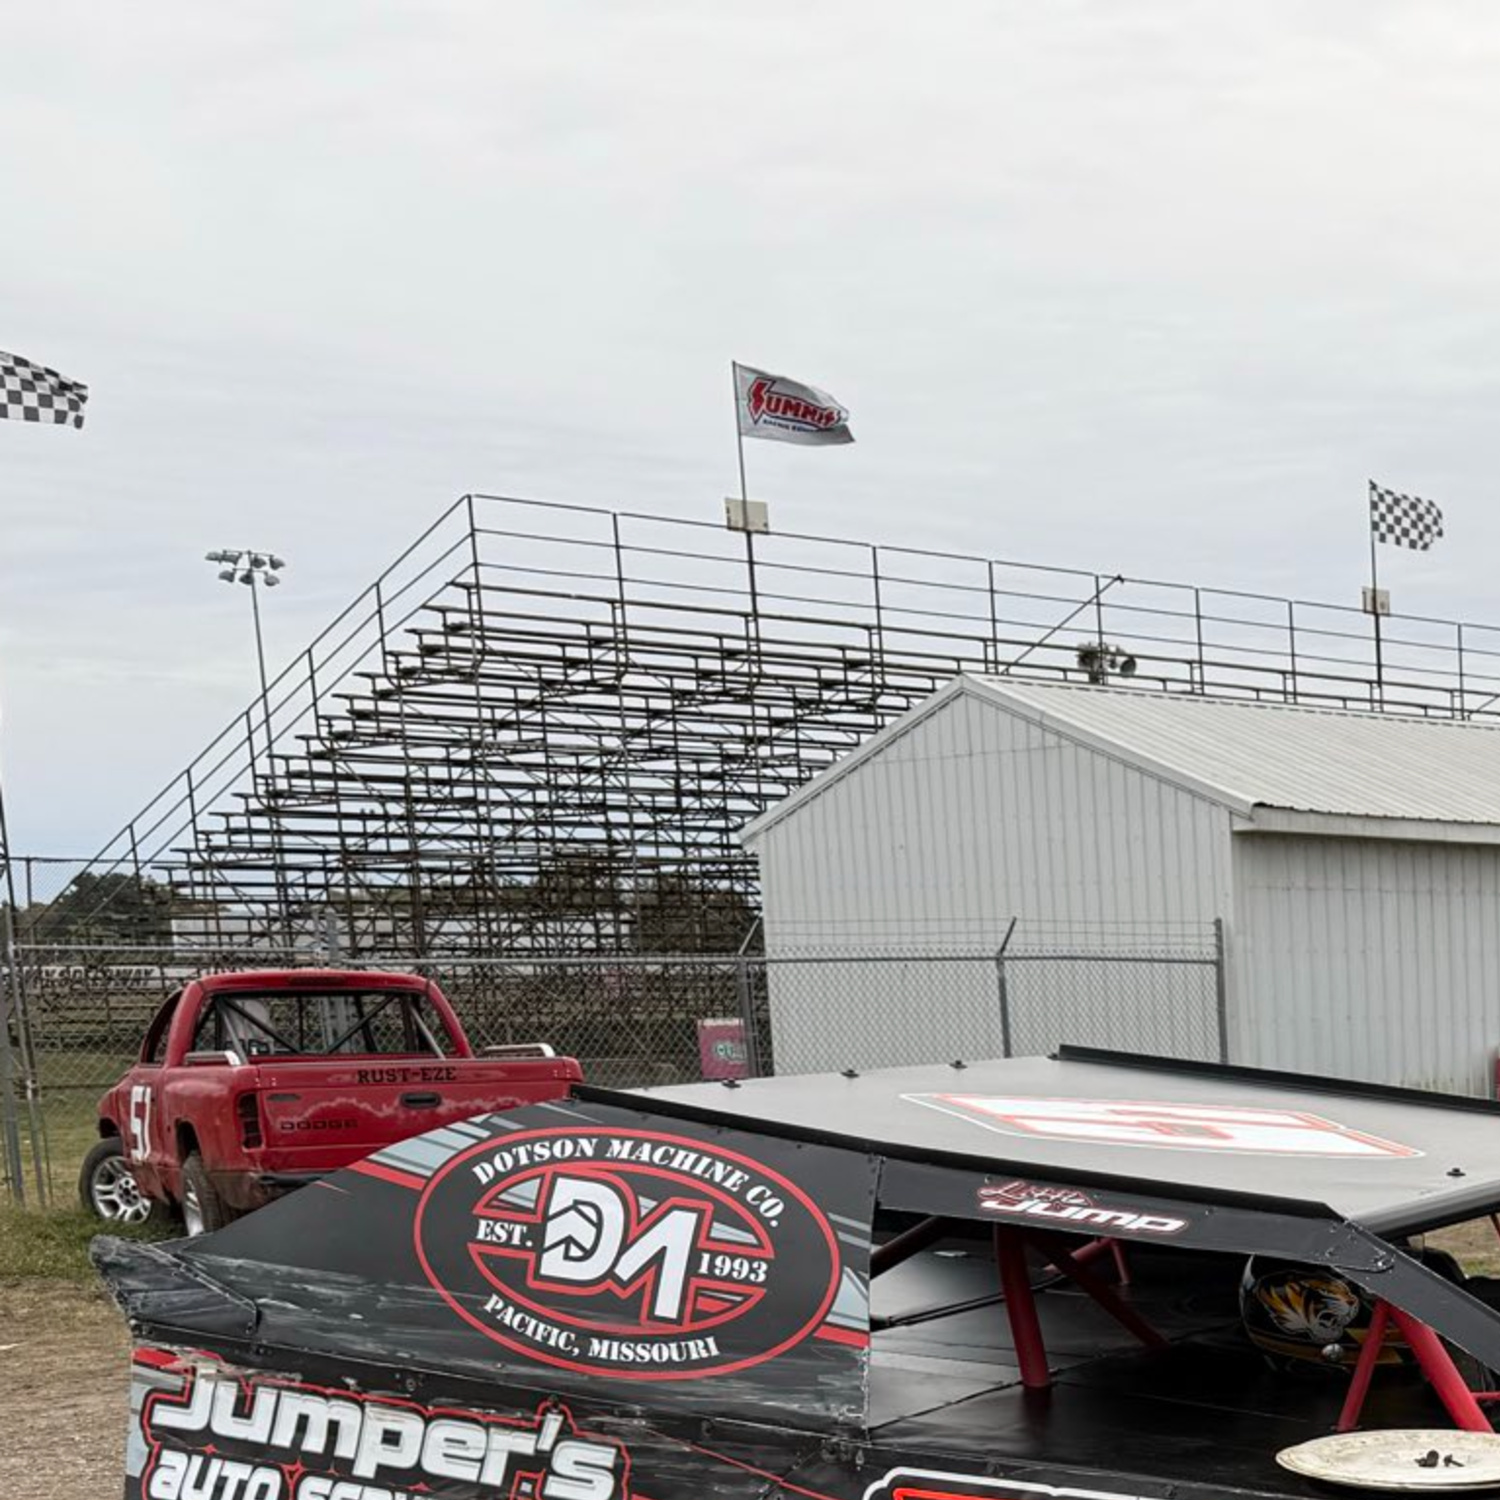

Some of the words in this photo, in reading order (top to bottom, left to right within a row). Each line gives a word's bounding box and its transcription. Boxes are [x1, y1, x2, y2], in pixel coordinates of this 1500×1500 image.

[357, 1066, 457, 1084] RUST-EZE
[281, 1119, 359, 1131] DODGE
[472, 1138, 598, 1186] DOTSON
[604, 1138, 751, 1192] MACHINE
[745, 1184, 787, 1229] CO.
[475, 1219, 534, 1248] EST.
[697, 1251, 769, 1283] 1993
[482, 1292, 581, 1357] PACIFIC,
[587, 1334, 721, 1364] MISSOURI
